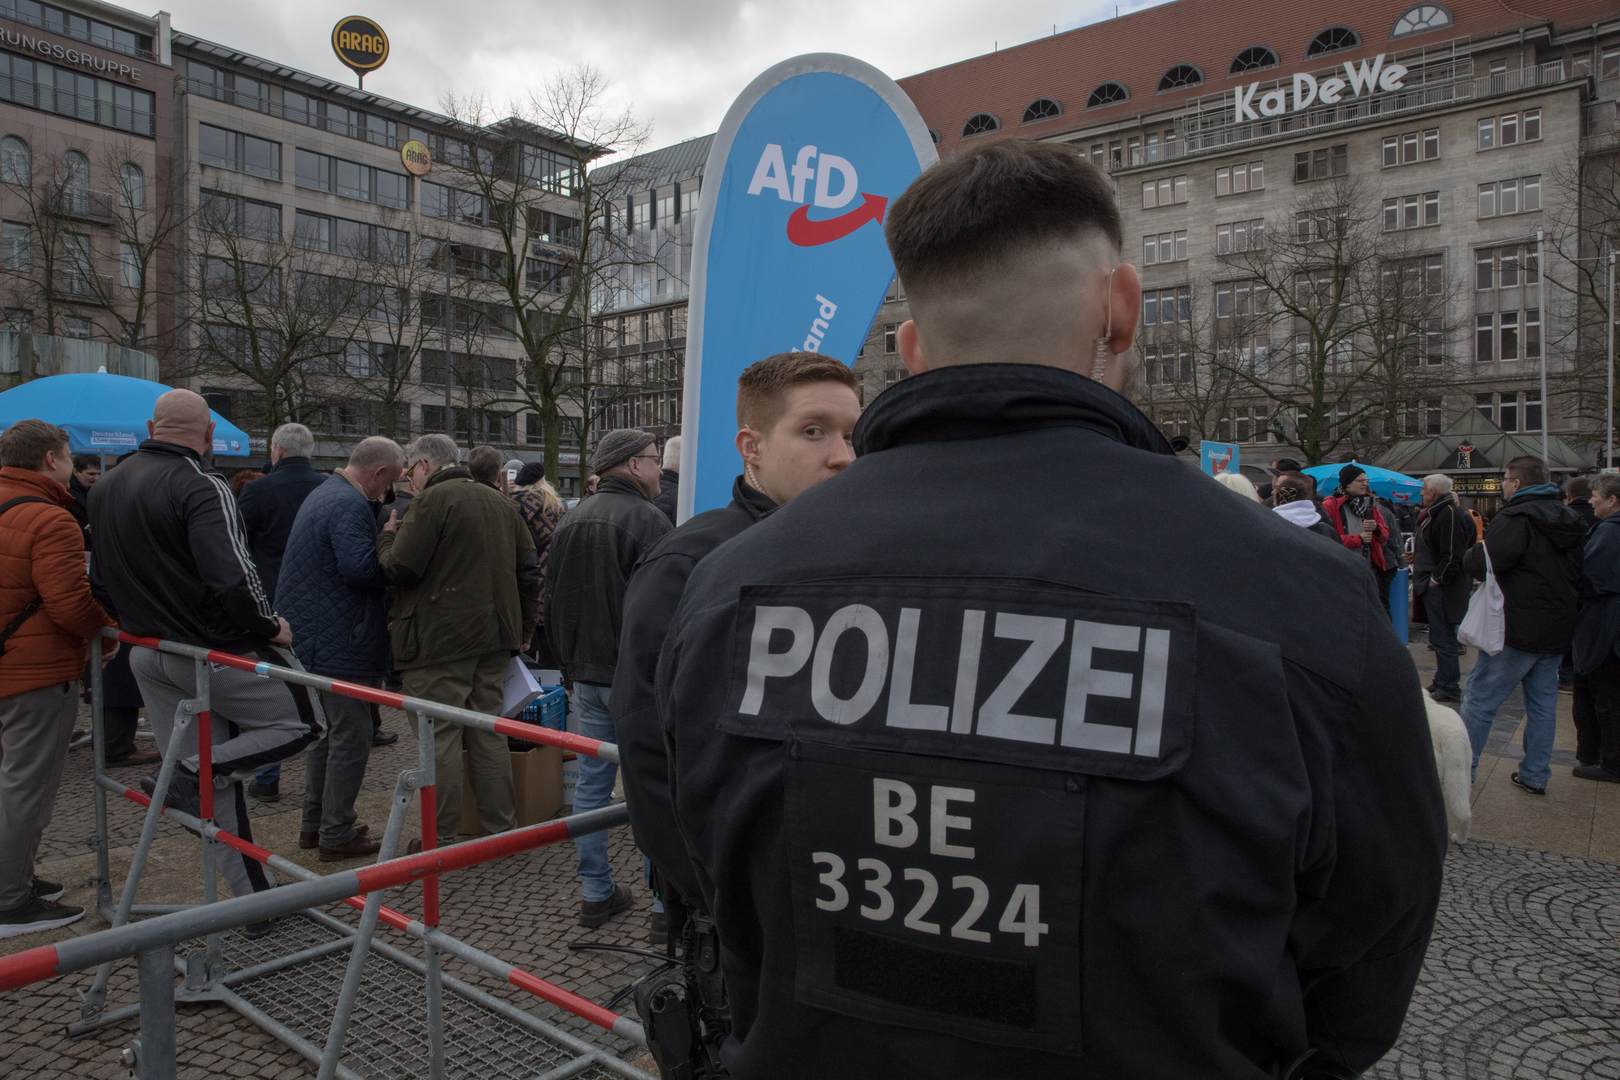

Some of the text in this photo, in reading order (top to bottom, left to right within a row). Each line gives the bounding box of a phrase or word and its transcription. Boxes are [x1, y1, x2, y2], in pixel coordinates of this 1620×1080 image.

[339, 30, 384, 55] ARAG
[1234, 53, 1408, 123] KaDeWe
[406, 149, 429, 165] ARAG
[747, 144, 858, 209] AfD
[791, 293, 838, 353] and
[1208, 450, 1230, 460] Alternative
[738, 604, 1170, 759] POLIZEI
[872, 777, 976, 860] BE
[811, 851, 1049, 948] 33224
